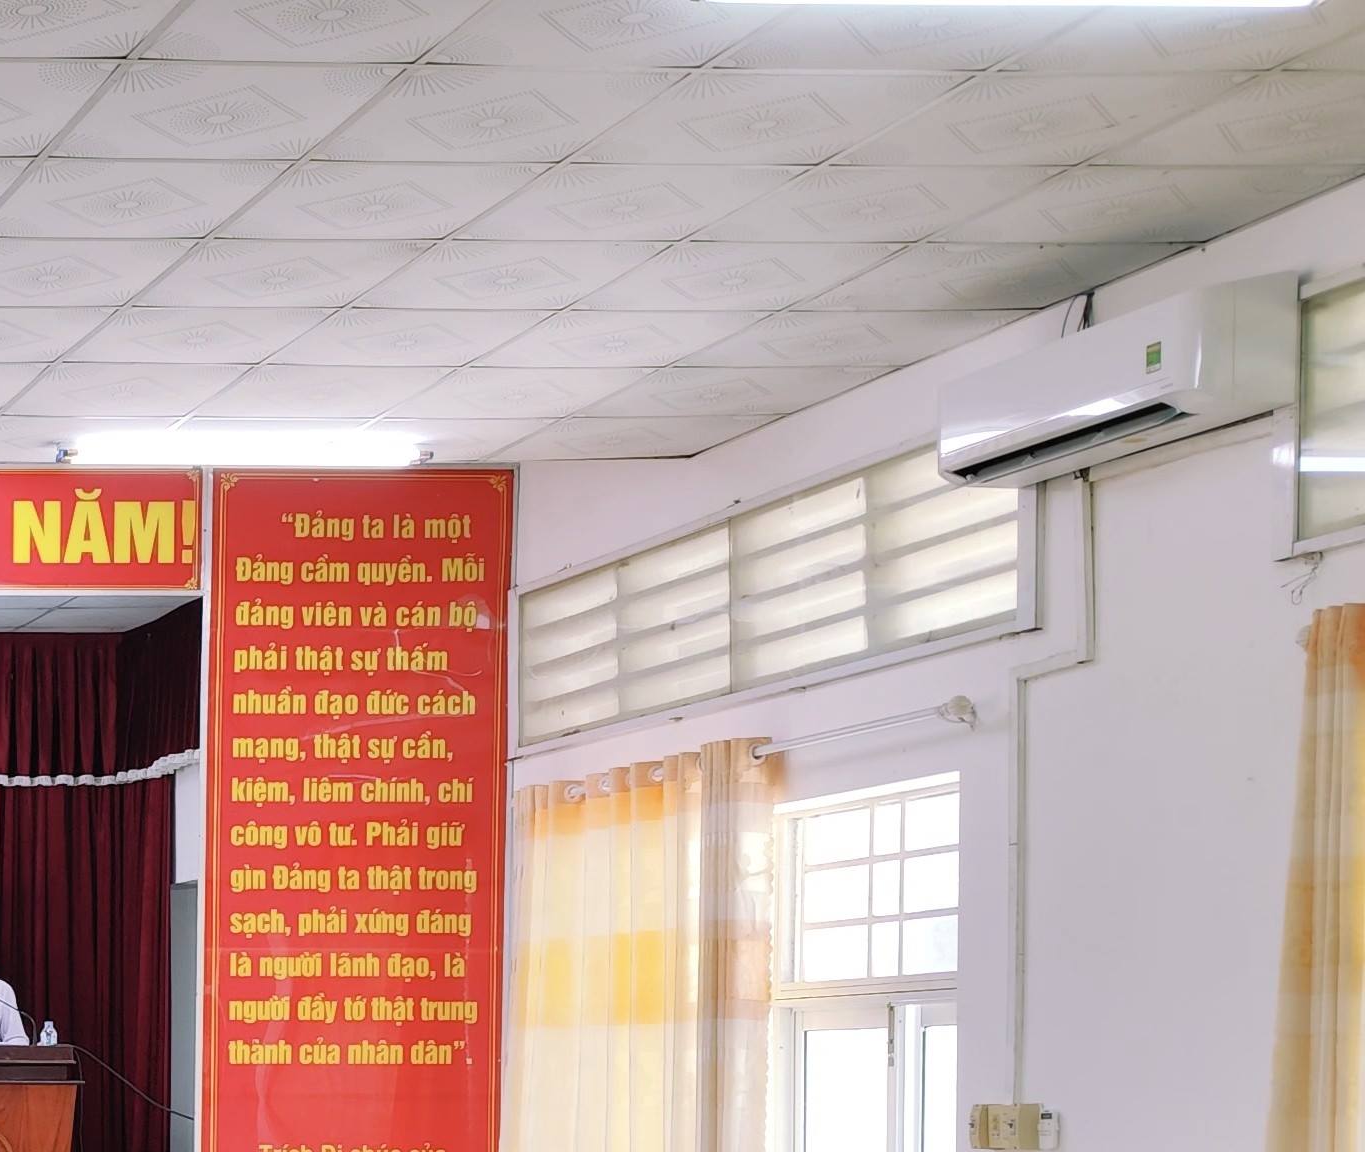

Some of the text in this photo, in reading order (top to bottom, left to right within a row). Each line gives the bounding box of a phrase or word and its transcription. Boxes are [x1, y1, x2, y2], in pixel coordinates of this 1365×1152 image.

[13, 487, 195, 566] NĂM!
[281, 511, 471, 543] “Đảng ta là một
[236, 554, 293, 584] Đảng
[301, 554, 350, 583] cầm
[357, 554, 433, 586] quyền.
[235, 598, 478, 632] đảng viên và cán bộ
